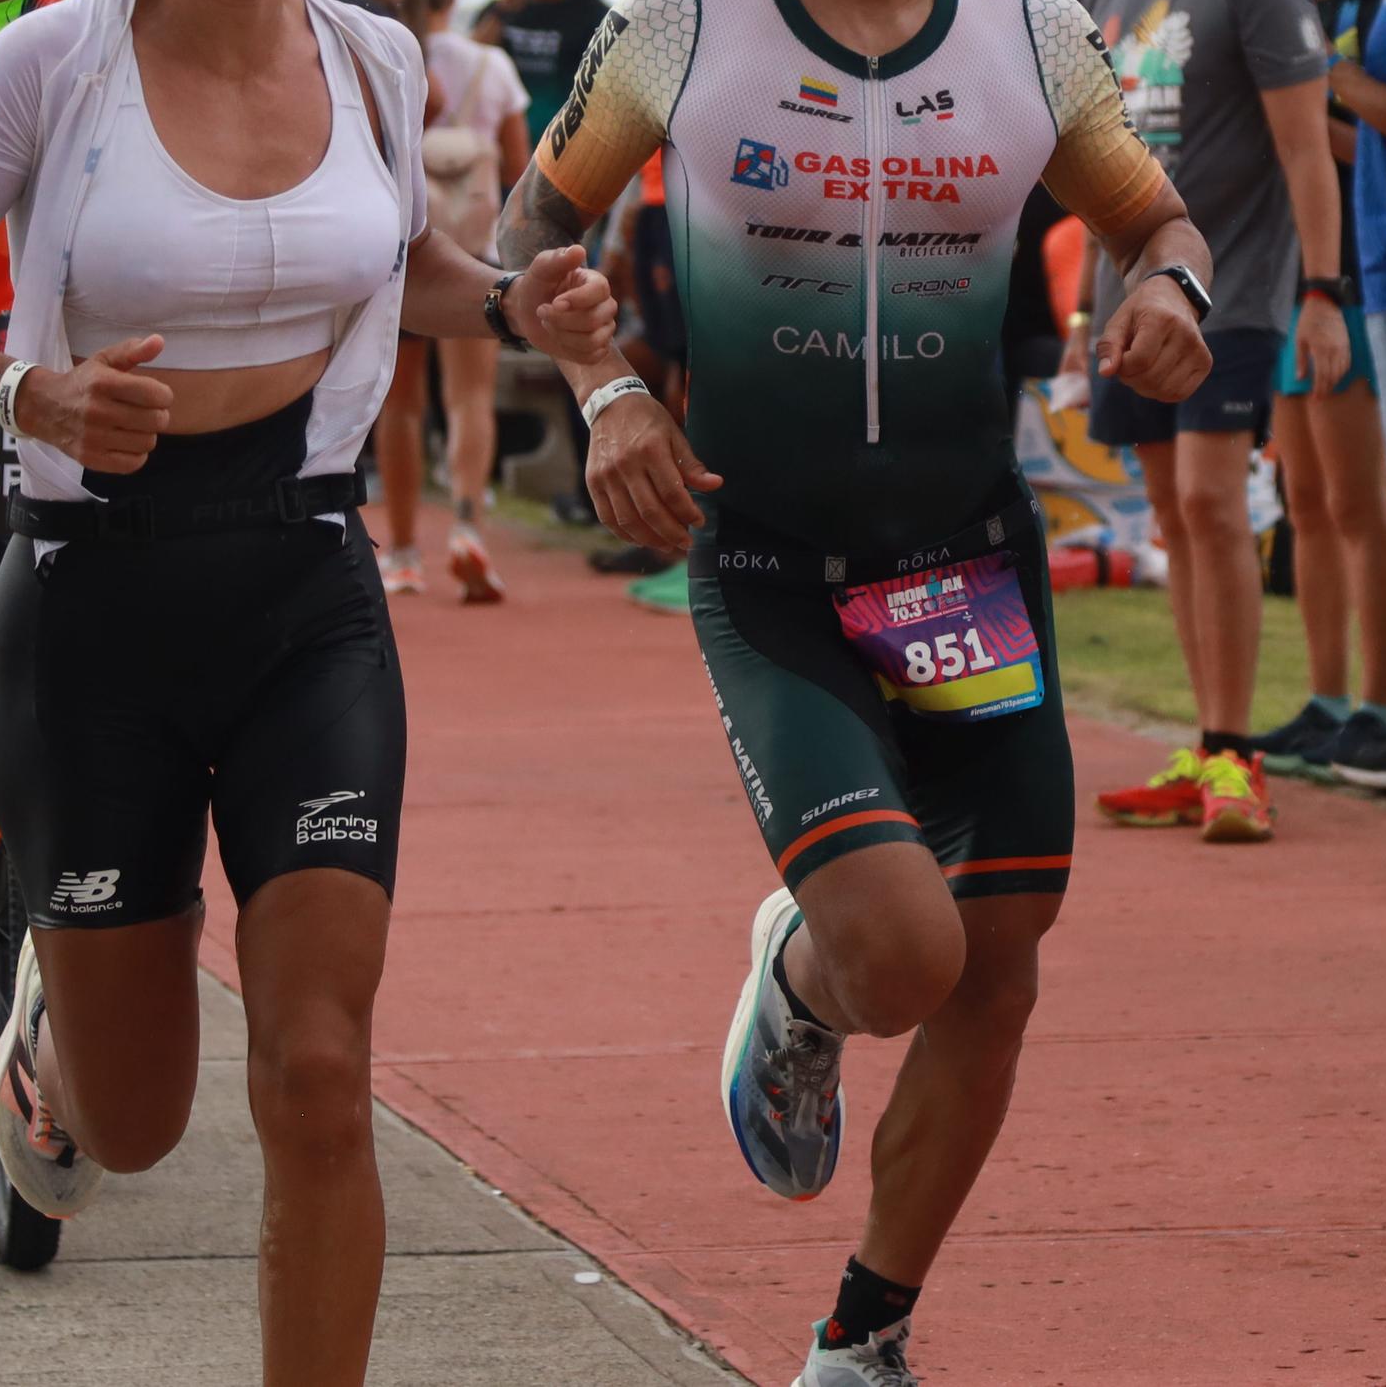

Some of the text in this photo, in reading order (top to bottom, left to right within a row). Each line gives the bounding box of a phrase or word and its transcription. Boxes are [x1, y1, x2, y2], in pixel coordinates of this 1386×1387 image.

[777, 99, 854, 124] SUAREZ
[895, 89, 955, 117] LAS
[794, 150, 1000, 179] GASOLINA
[823, 178, 961, 204] EXTRA
[745, 221, 832, 244] TOUR
[877, 231, 982, 247] NATIVA
[899, 245, 975, 258] BICICLETAS
[891, 277, 972, 295] CRONO
[772, 325, 946, 361] CAMILO
[886, 574, 965, 609] IRONMAN
[889, 602, 923, 623] 70.3
[905, 627, 996, 684] 851
[731, 736, 774, 820] NATIVA
[801, 787, 881, 826] SUAREZ
[296, 814, 379, 833] Running
[296, 826, 378, 845] Balboa
[49, 900, 124, 914] new balance
